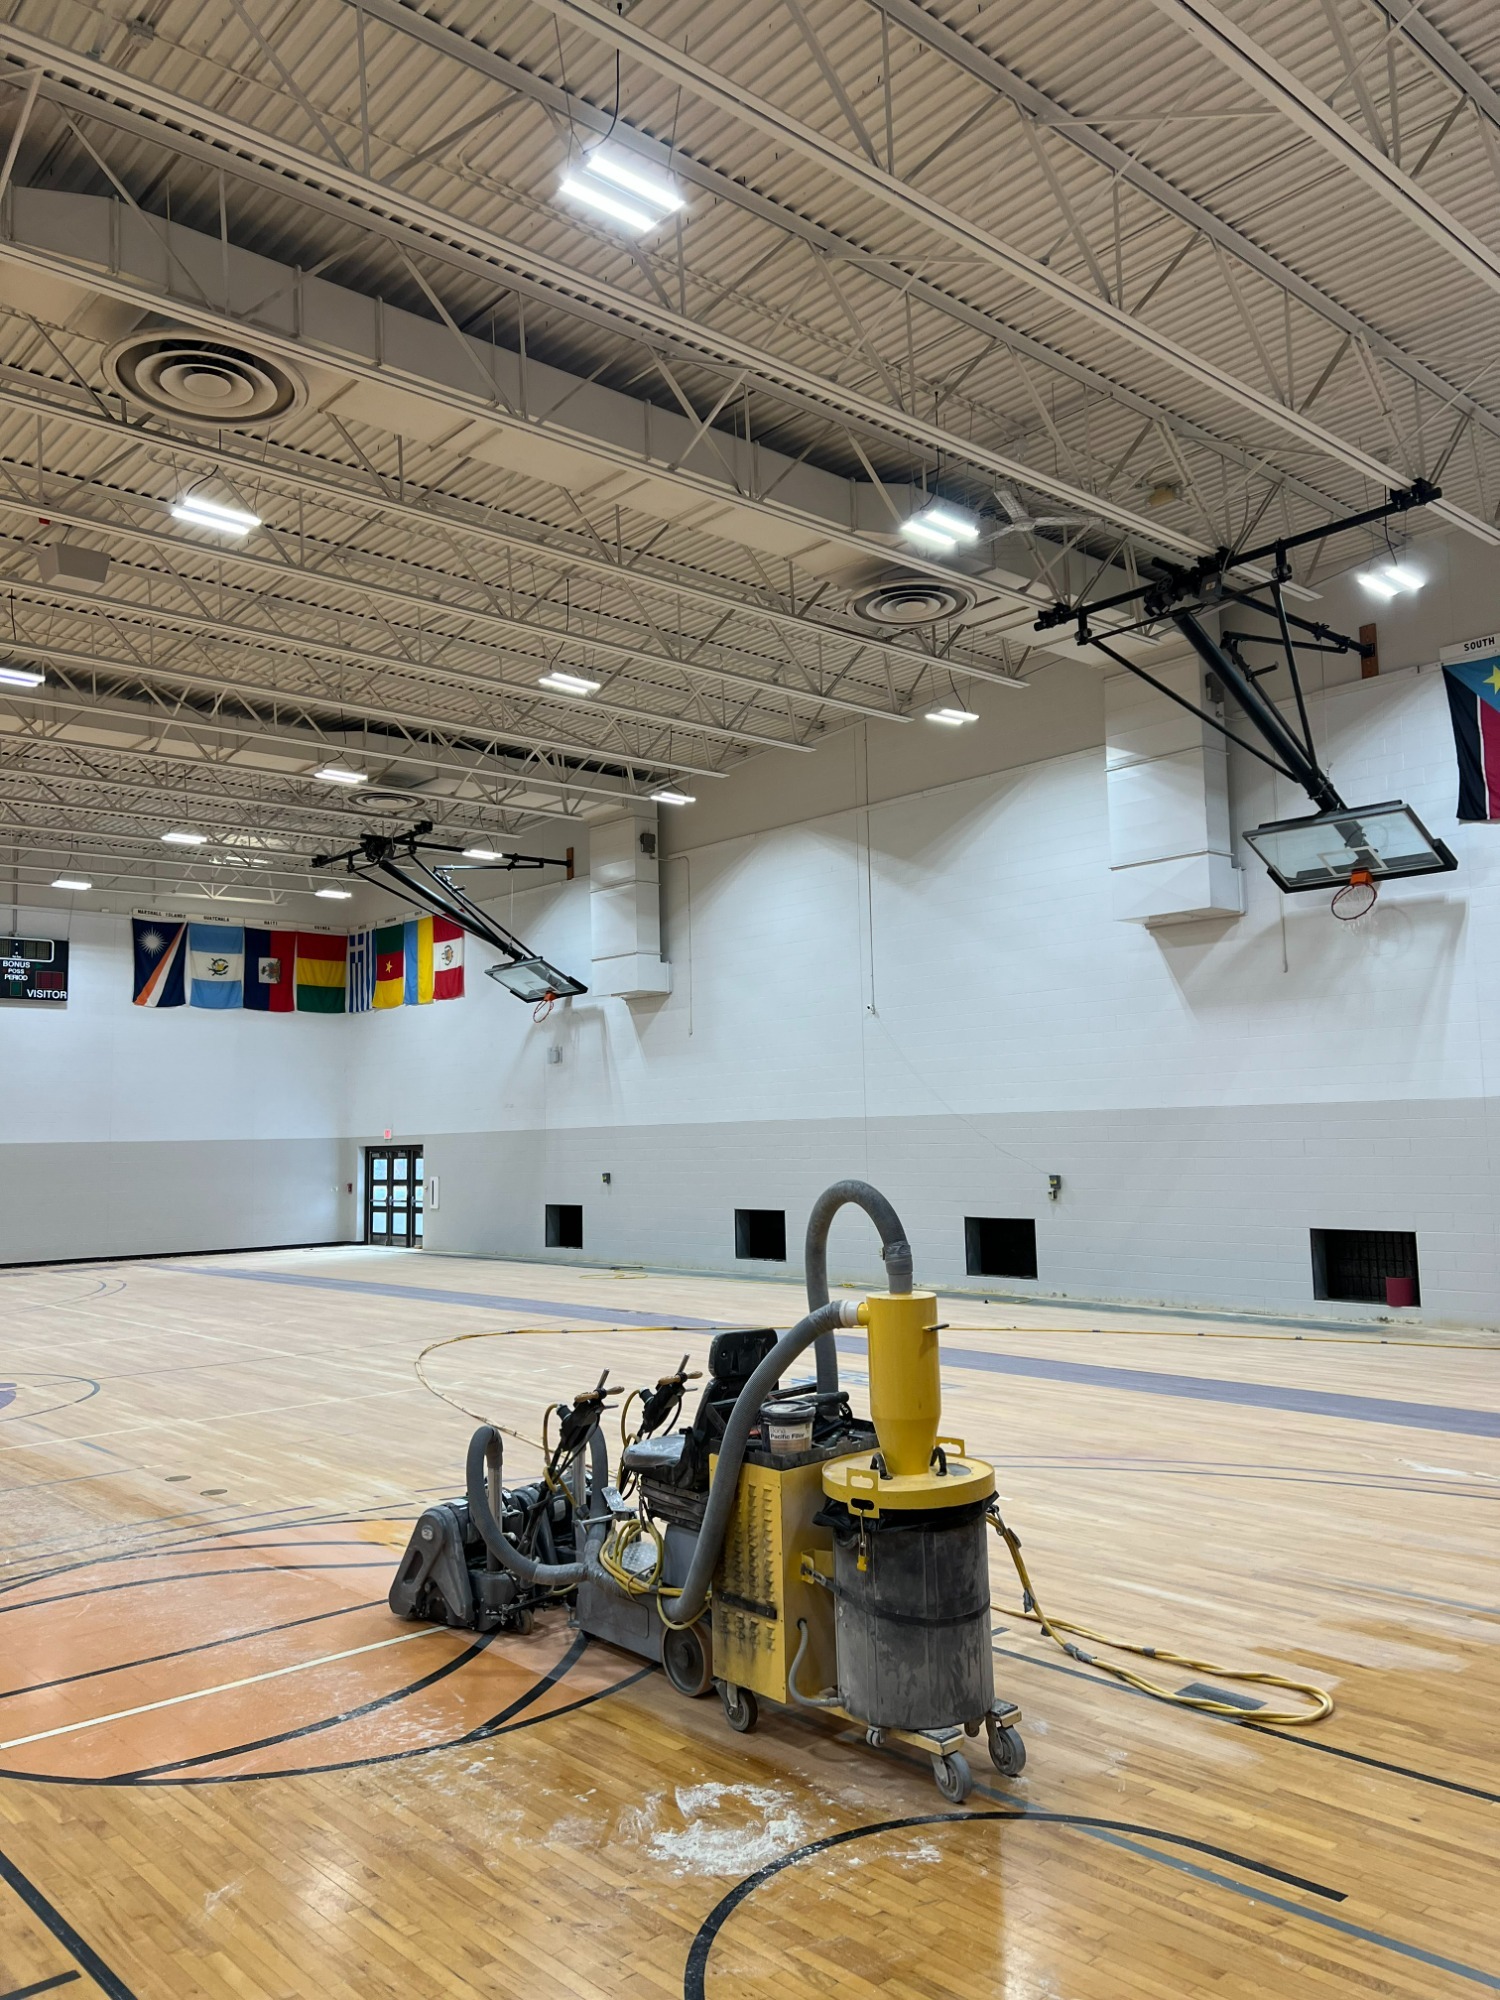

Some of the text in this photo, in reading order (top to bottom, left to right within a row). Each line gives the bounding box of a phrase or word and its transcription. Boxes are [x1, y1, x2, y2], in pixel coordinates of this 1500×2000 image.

[1463, 636, 1496, 652] SOUTH
[2, 960, 31, 969] BONUS
[26, 988, 67, 999] VISITOR
